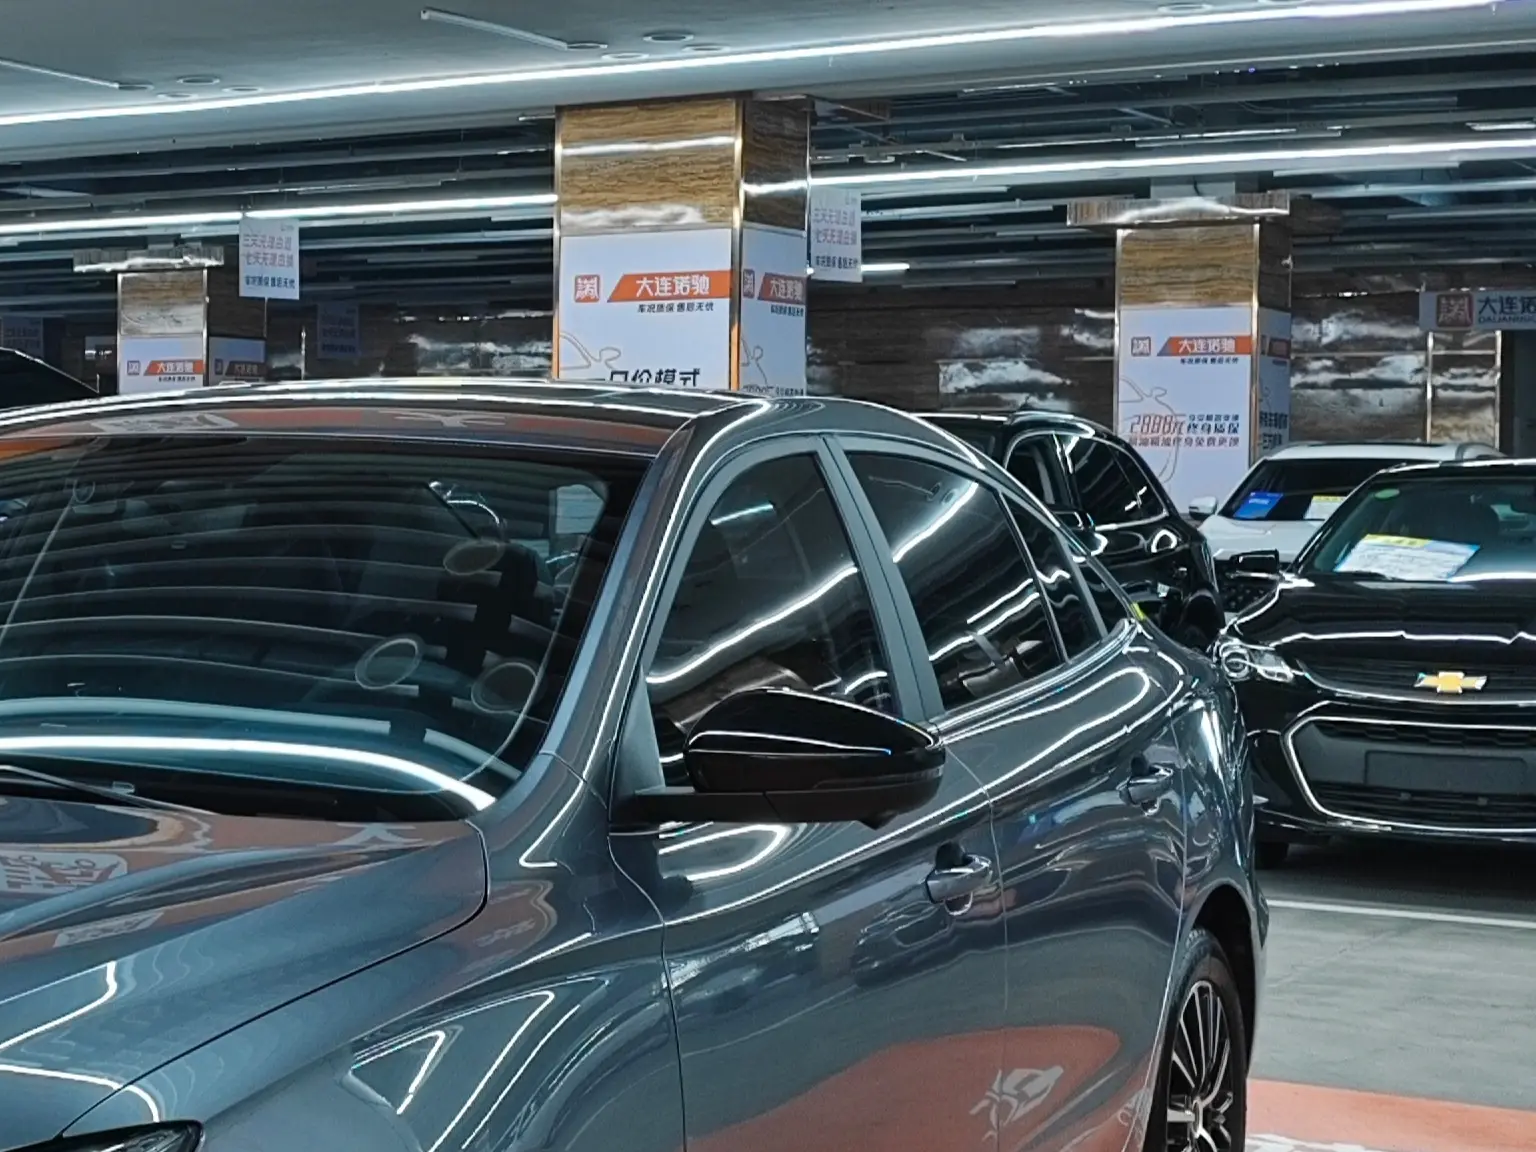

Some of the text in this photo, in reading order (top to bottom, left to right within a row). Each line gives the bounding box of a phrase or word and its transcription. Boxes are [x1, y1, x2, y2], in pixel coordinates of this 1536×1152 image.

[636, 274, 710, 298] 大连诺驰
[1178, 338, 1236, 354] 大连诺驰
